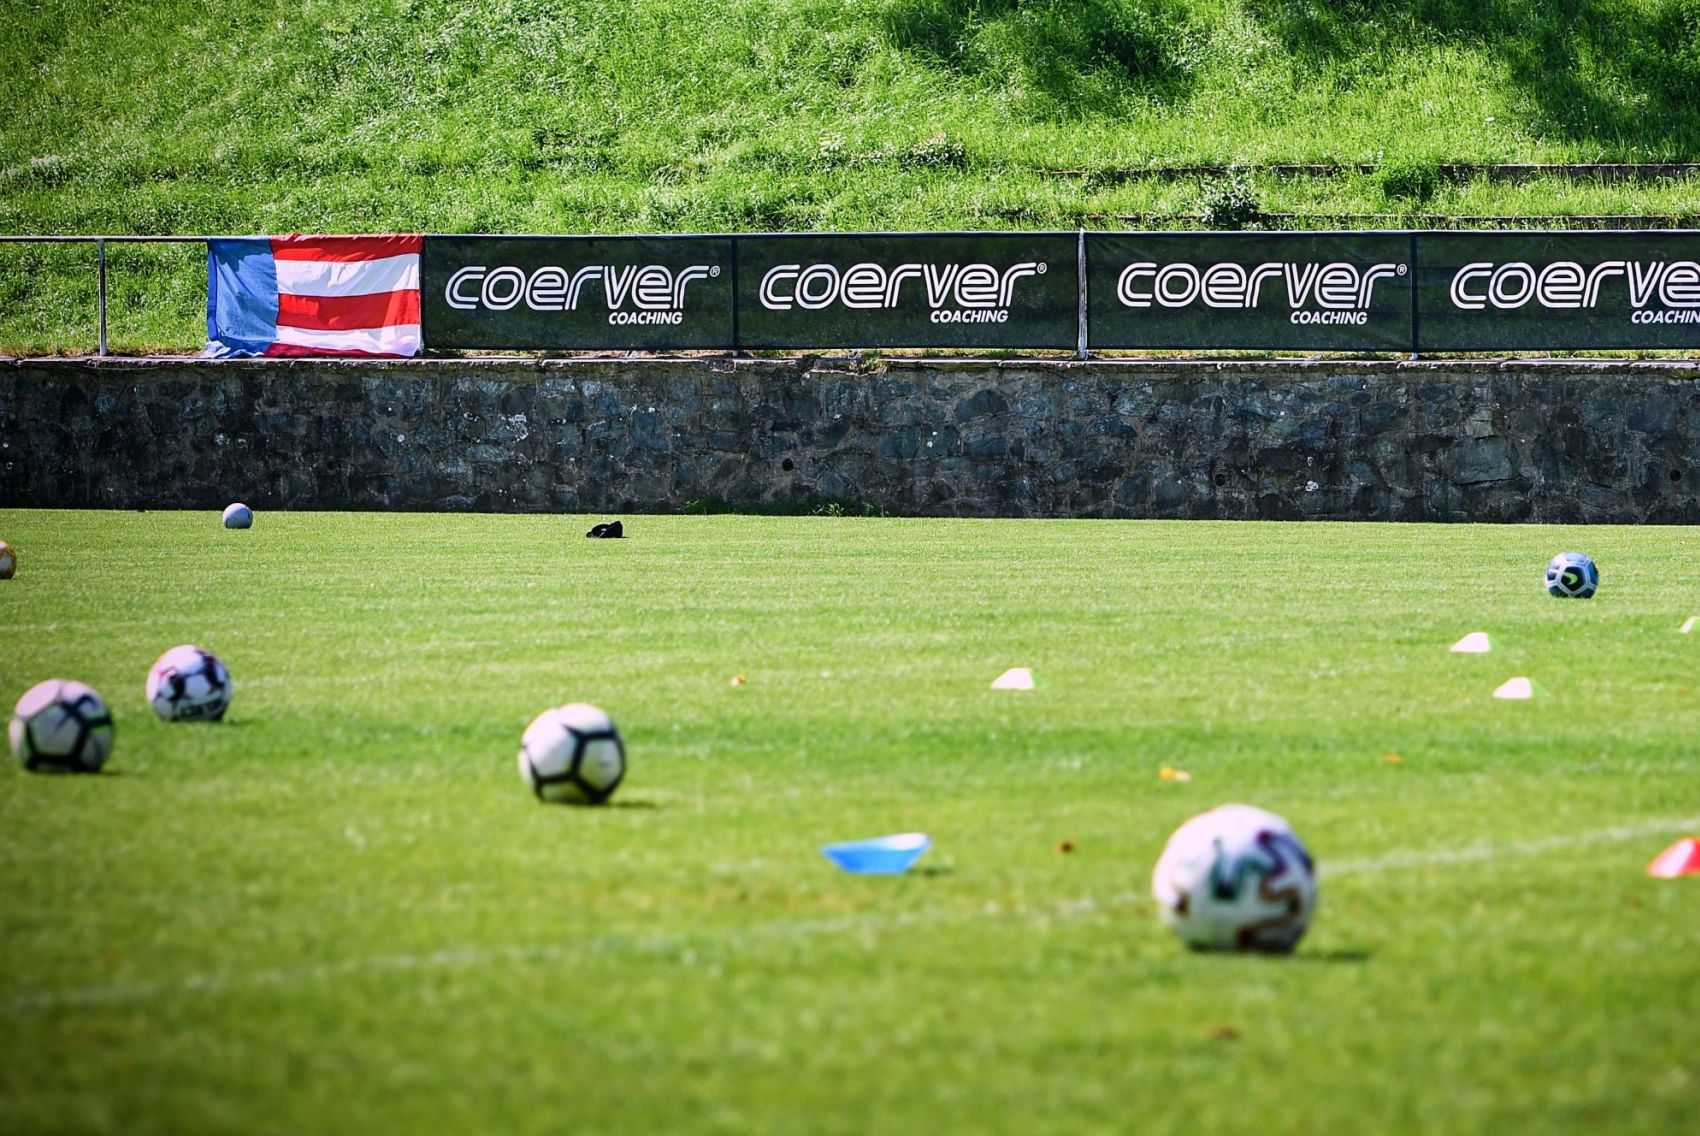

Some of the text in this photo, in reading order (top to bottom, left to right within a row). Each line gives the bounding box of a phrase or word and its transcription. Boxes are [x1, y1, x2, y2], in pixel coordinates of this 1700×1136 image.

[1450, 261, 1700, 310] coerve
[608, 311, 683, 325] COACHING
[930, 309, 1009, 324] COACHING
[1290, 310, 1368, 325] COACHING
[1631, 310, 1700, 325] COACHIN
